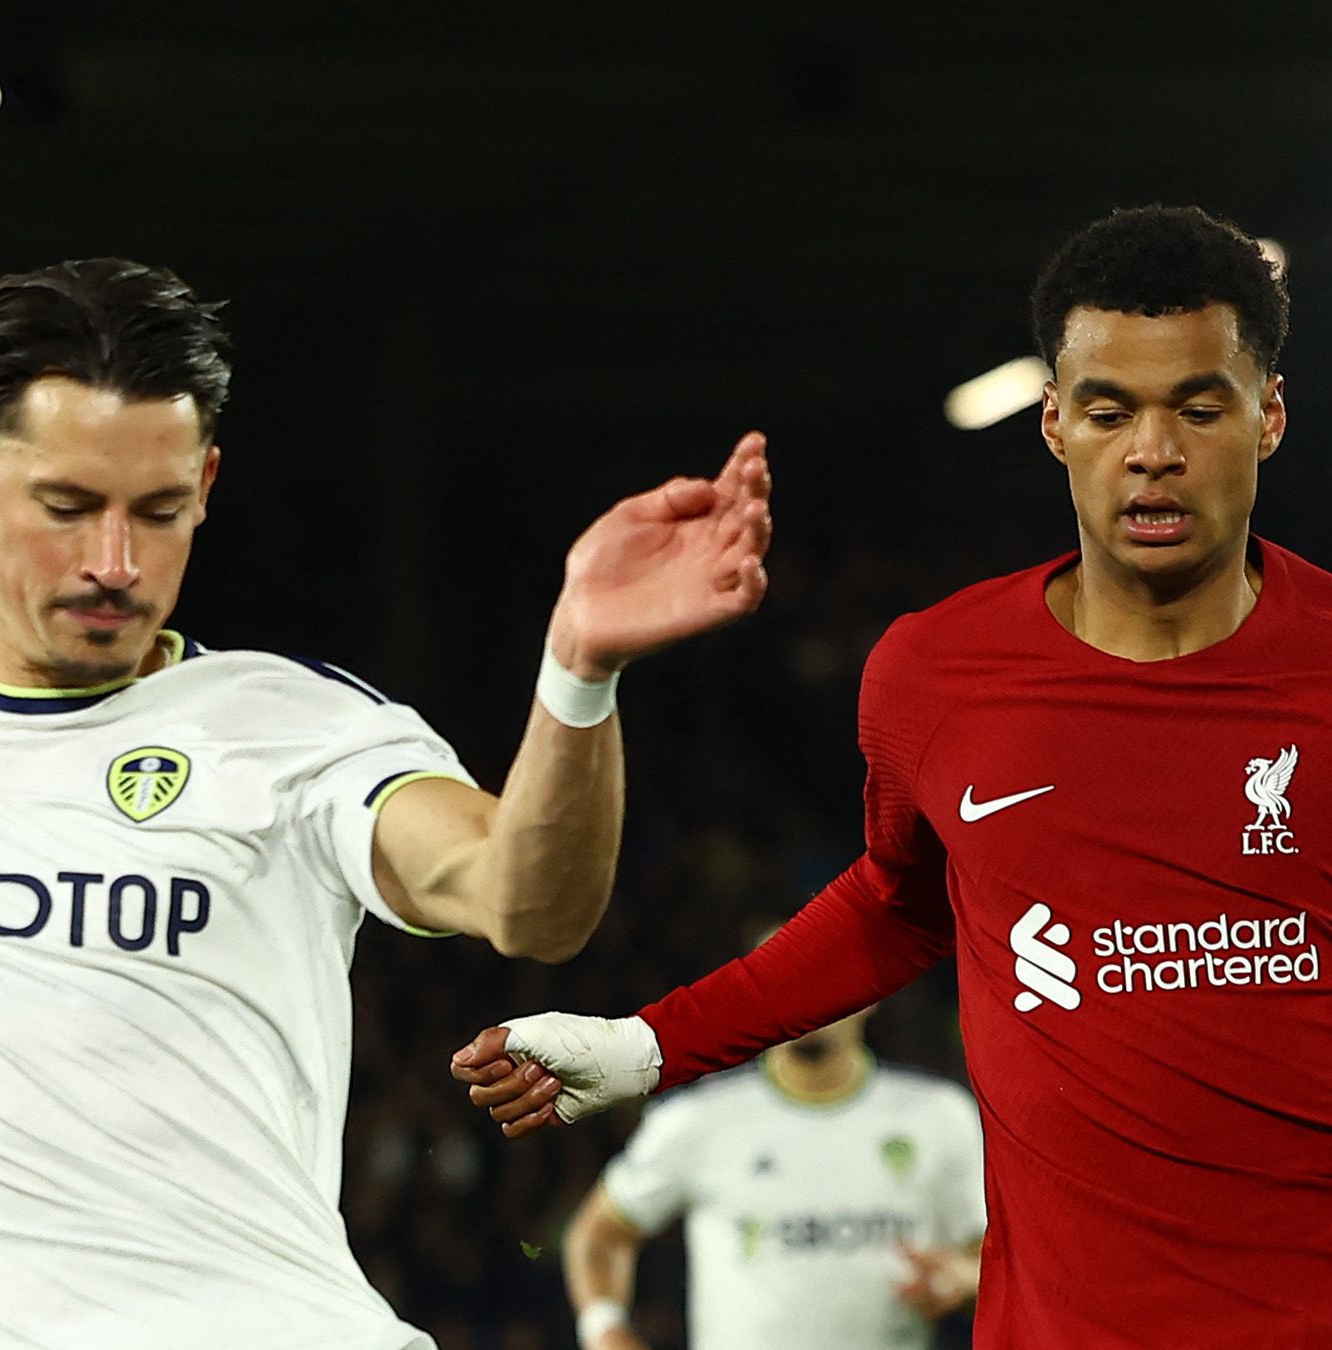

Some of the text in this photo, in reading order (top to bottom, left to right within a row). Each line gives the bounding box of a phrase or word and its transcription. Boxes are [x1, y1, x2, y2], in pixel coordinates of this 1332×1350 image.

[1242, 831, 1300, 855] L.F.C.
[1092, 911, 1306, 957] standard
[1097, 944, 1318, 994] chartered
